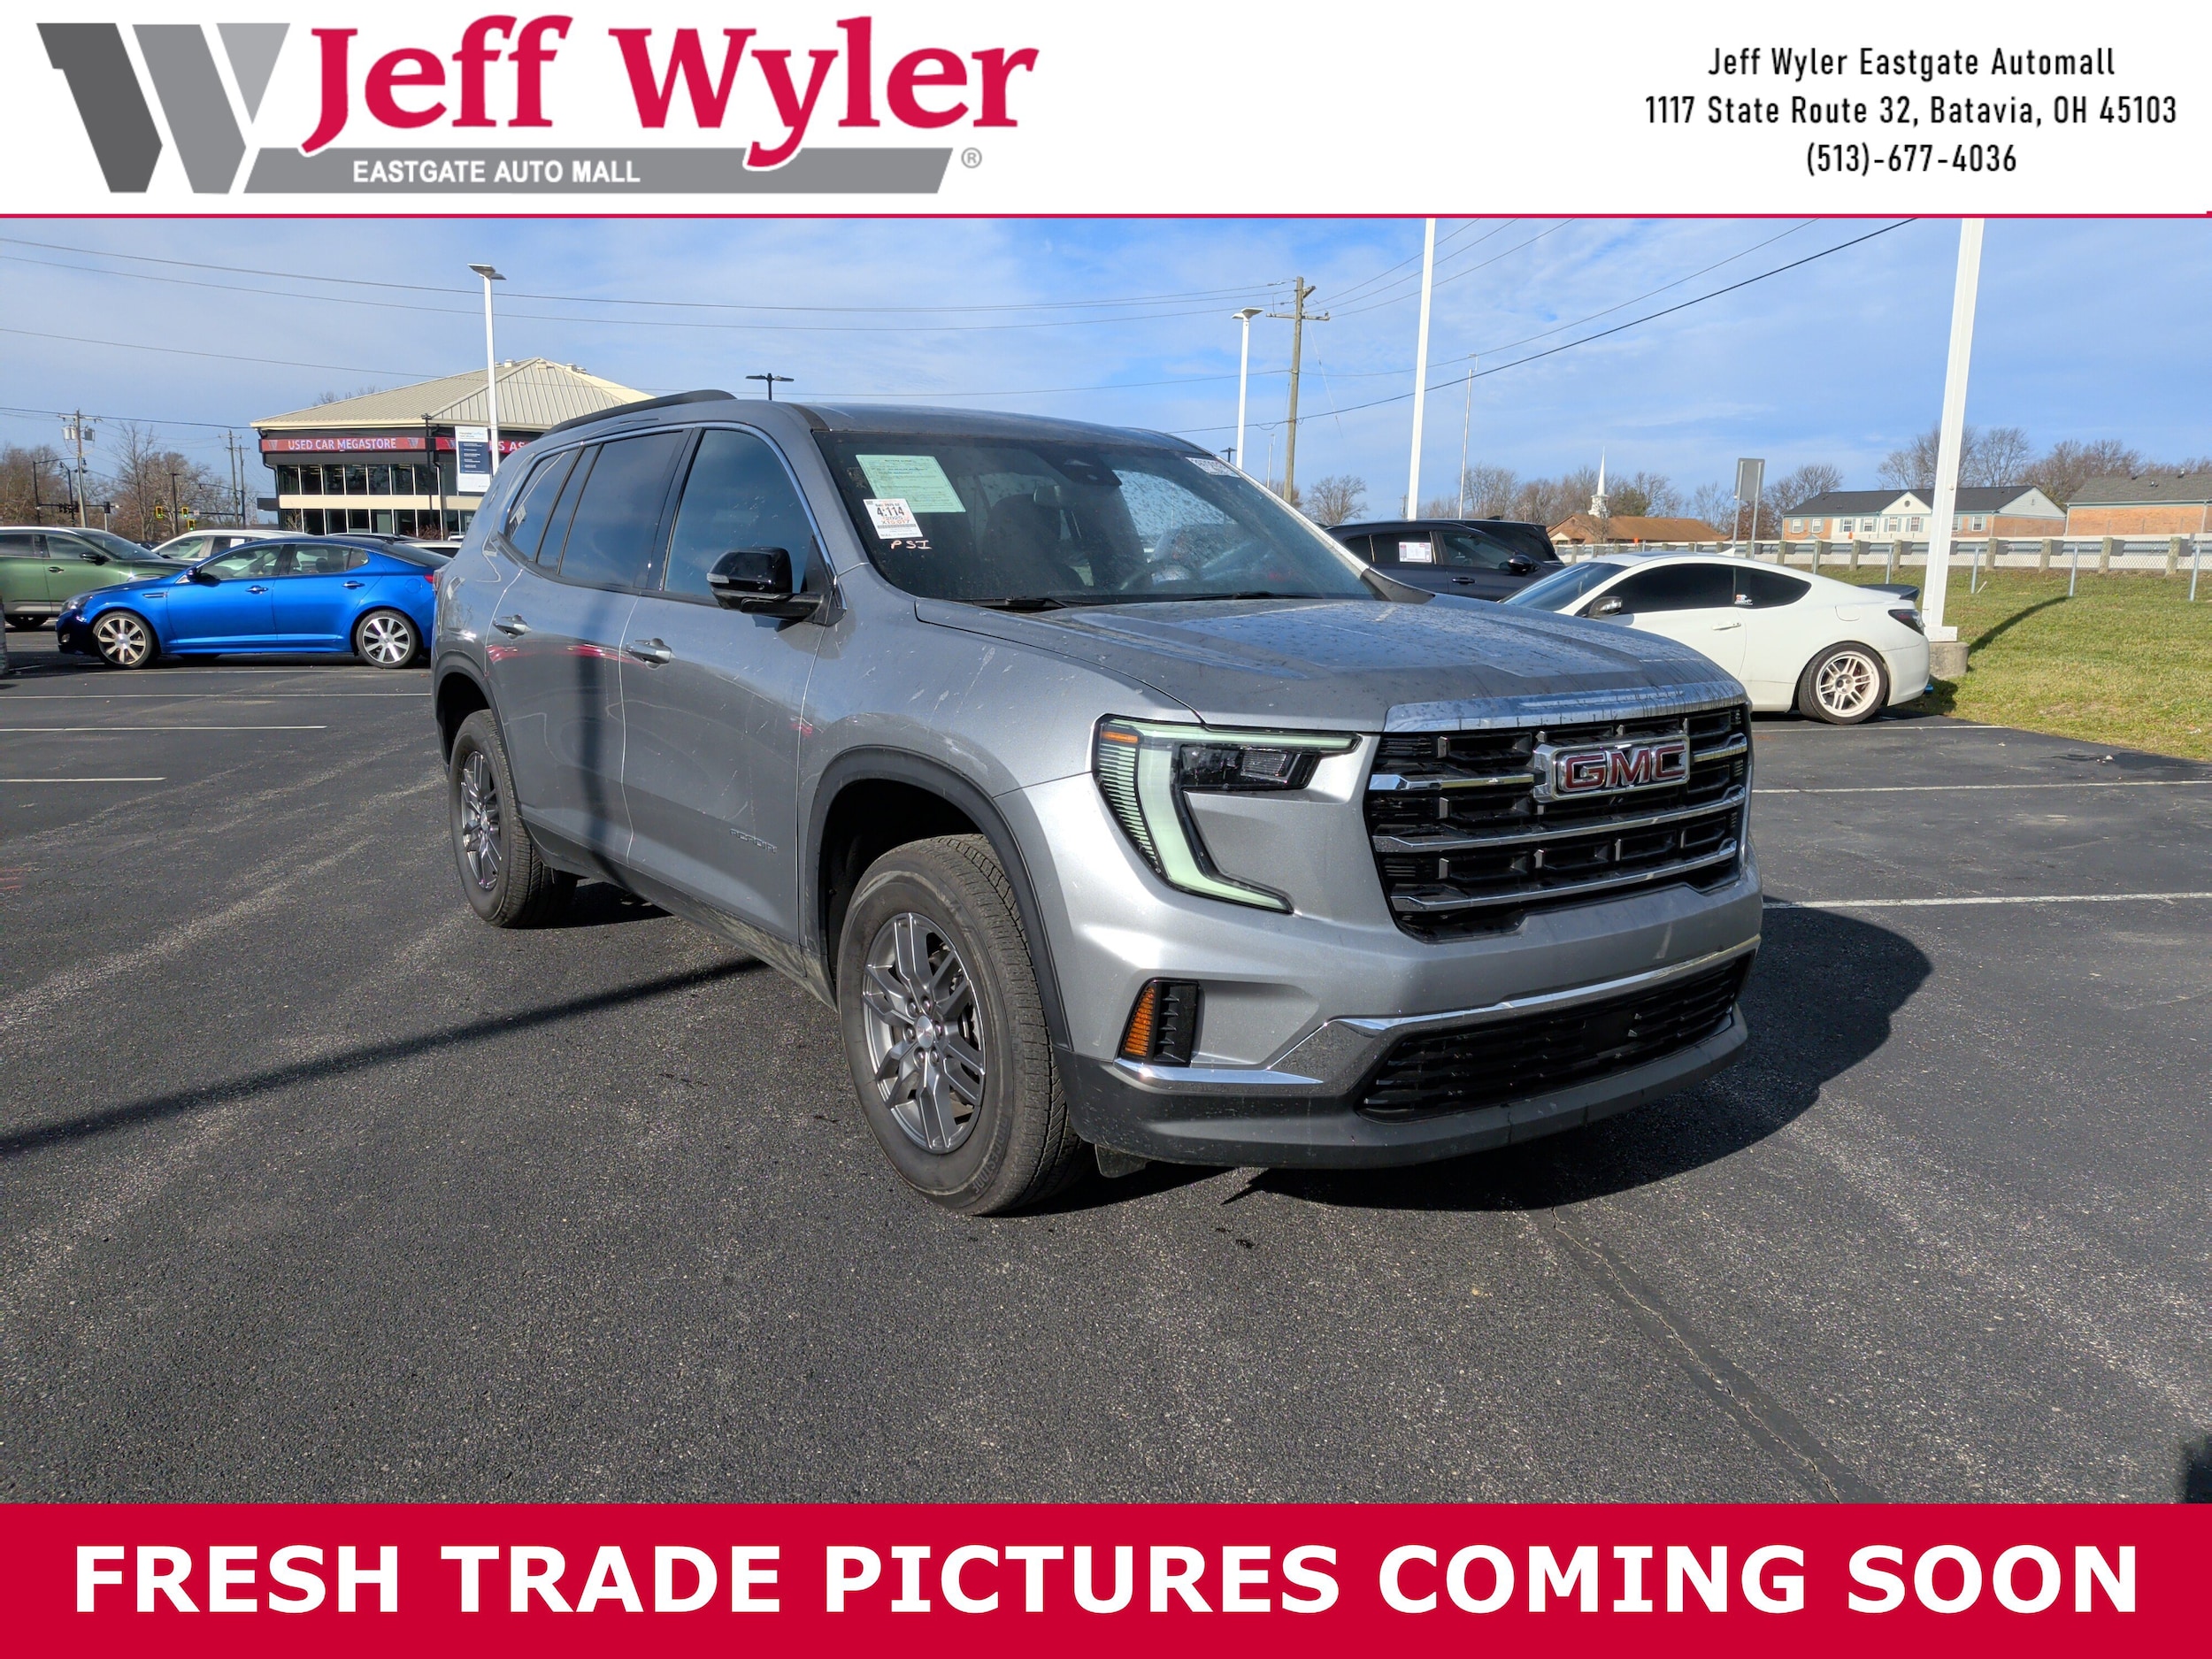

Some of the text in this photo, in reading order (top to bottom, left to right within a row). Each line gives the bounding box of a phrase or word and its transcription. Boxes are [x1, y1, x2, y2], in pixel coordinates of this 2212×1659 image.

[288, 438, 397, 450] USED CAR MEGASTORE
[1557, 741, 1687, 793] GMC
